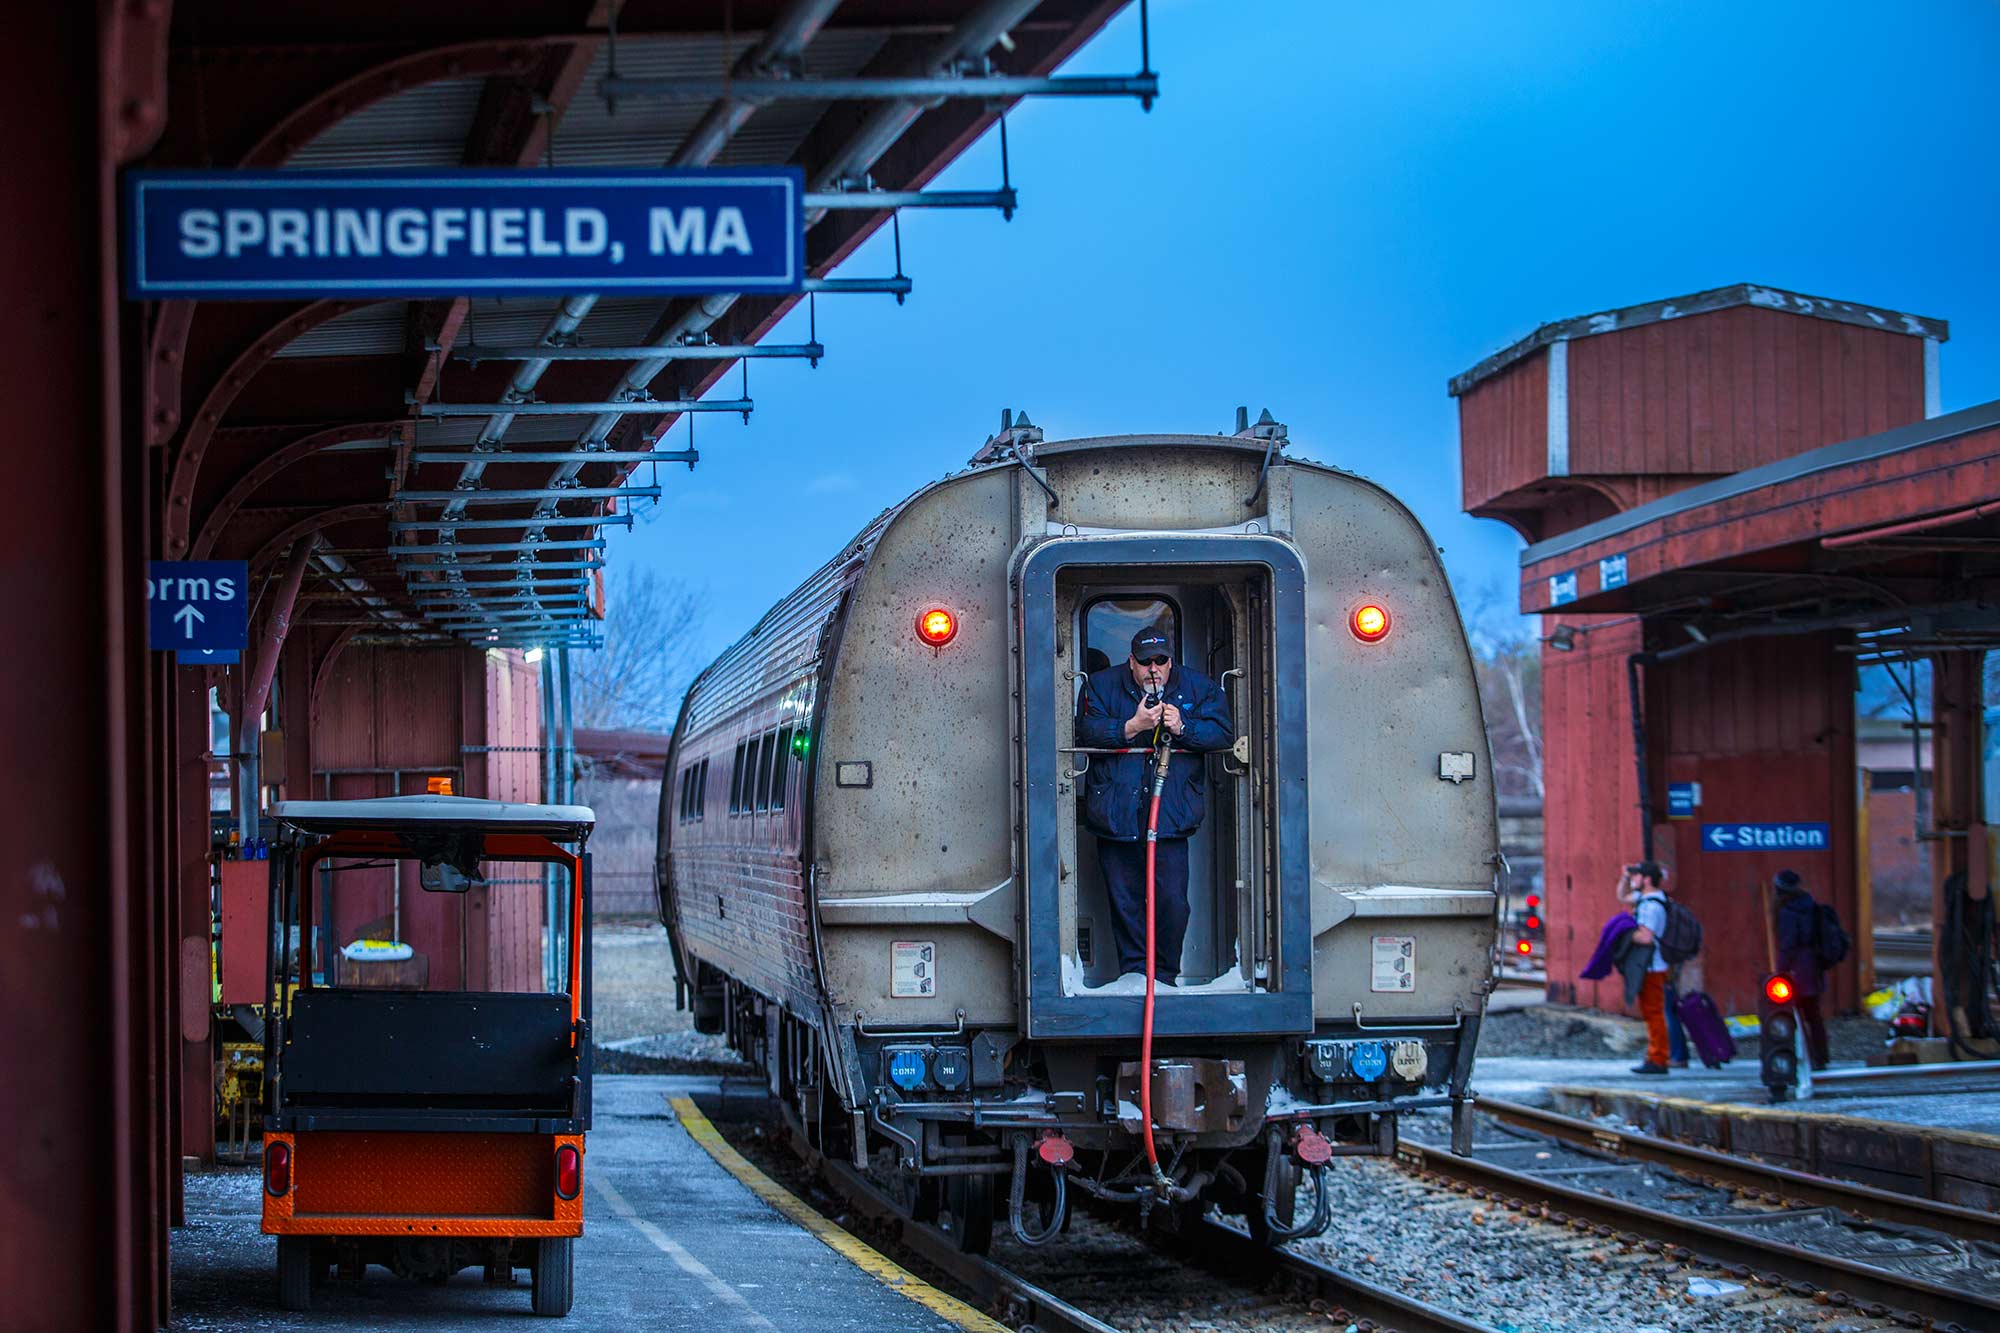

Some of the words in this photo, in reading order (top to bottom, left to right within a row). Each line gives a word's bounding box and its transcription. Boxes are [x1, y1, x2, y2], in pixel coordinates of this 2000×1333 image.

[178, 207, 624, 264] SPRINGFIELD,
[647, 207, 753, 256] MA
[1737, 825, 1825, 847] Station
[892, 1067, 916, 1076] COMM
[943, 1066, 955, 1075] MU
